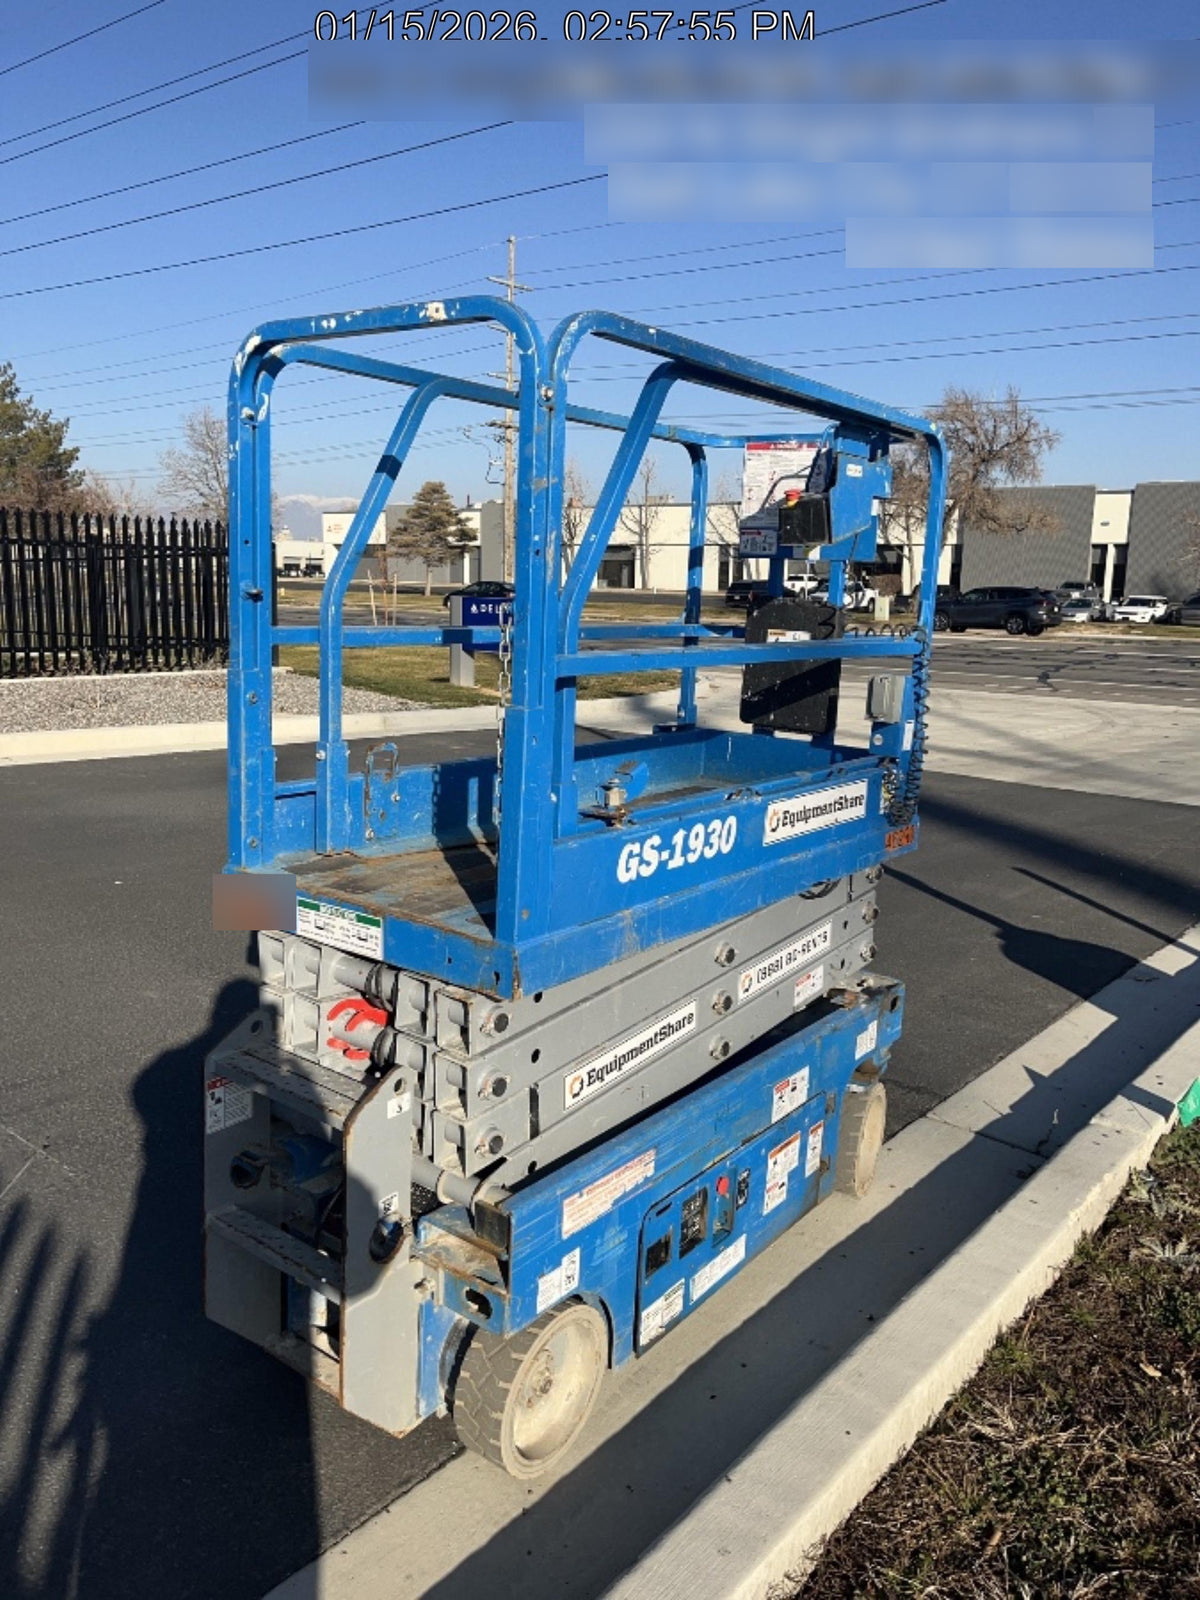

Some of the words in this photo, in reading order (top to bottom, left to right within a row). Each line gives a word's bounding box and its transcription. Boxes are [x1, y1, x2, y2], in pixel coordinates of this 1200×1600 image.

[780, 795, 866, 828] EquipmentShare
[616, 814, 738, 884] GS-1930
[585, 1011, 696, 1088] EquipmentShare
